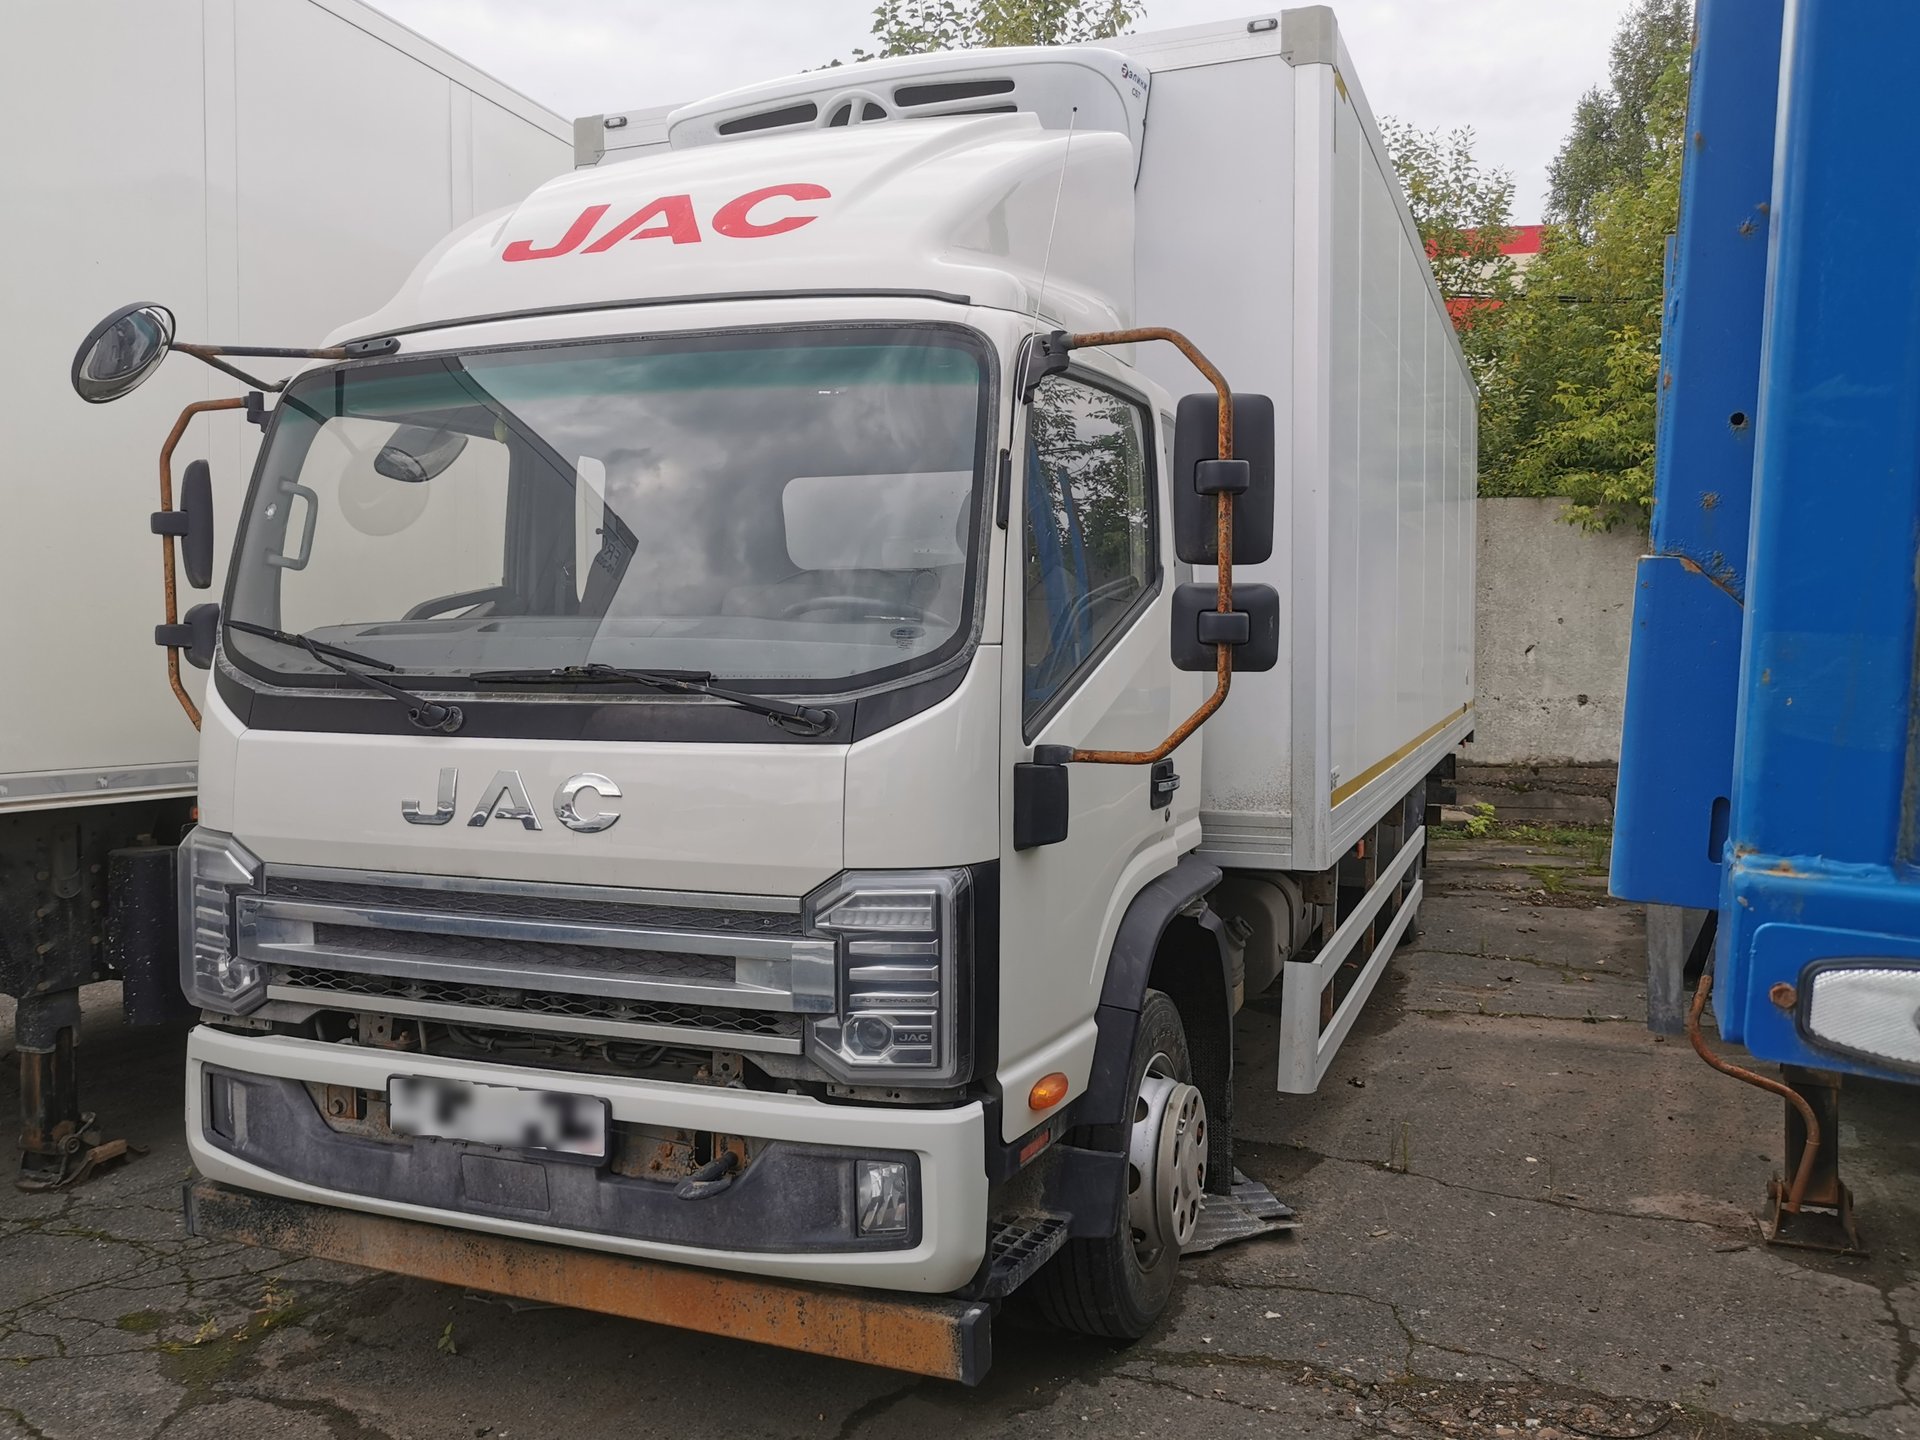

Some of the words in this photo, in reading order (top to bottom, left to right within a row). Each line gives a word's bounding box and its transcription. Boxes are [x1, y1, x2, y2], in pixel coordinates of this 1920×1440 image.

[502, 183, 832, 262] JAC
[402, 767, 623, 833] JAC
[898, 1033, 929, 1042] JAC
